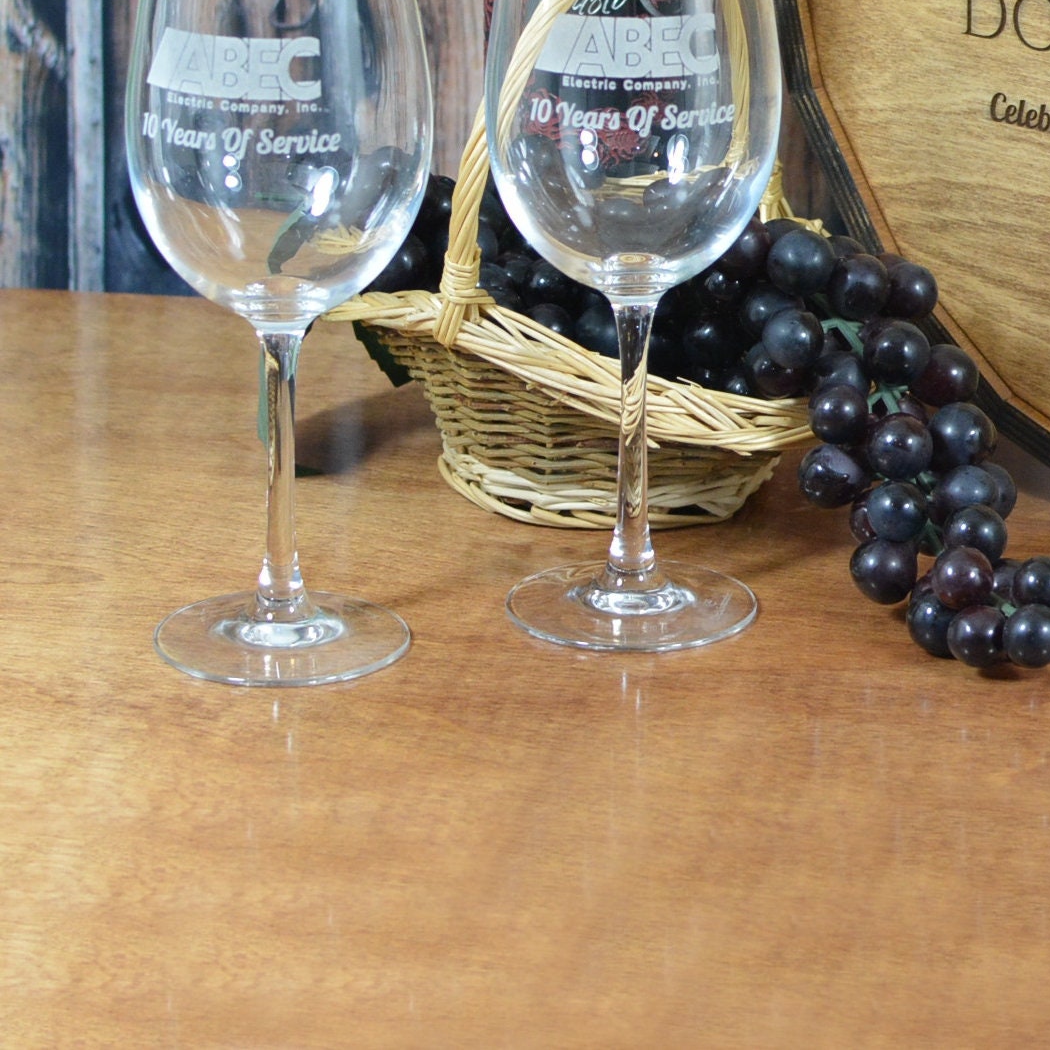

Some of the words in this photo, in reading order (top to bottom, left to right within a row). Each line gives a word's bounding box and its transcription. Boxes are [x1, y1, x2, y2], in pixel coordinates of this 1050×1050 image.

[562, 12, 720, 78] ABEC
[168, 34, 322, 101] ABEC
[562, 76, 616, 90] Electric
[167, 92, 214, 109] Electric
[530, 98, 553, 124] 10
[555, 101, 621, 130] Years
[626, 105, 659, 138] Of
[660, 102, 737, 131] Service
[142, 112, 159, 139] 10
[161, 118, 217, 150] Years
[221, 127, 255, 161] Of
[256, 128, 342, 155] Service
